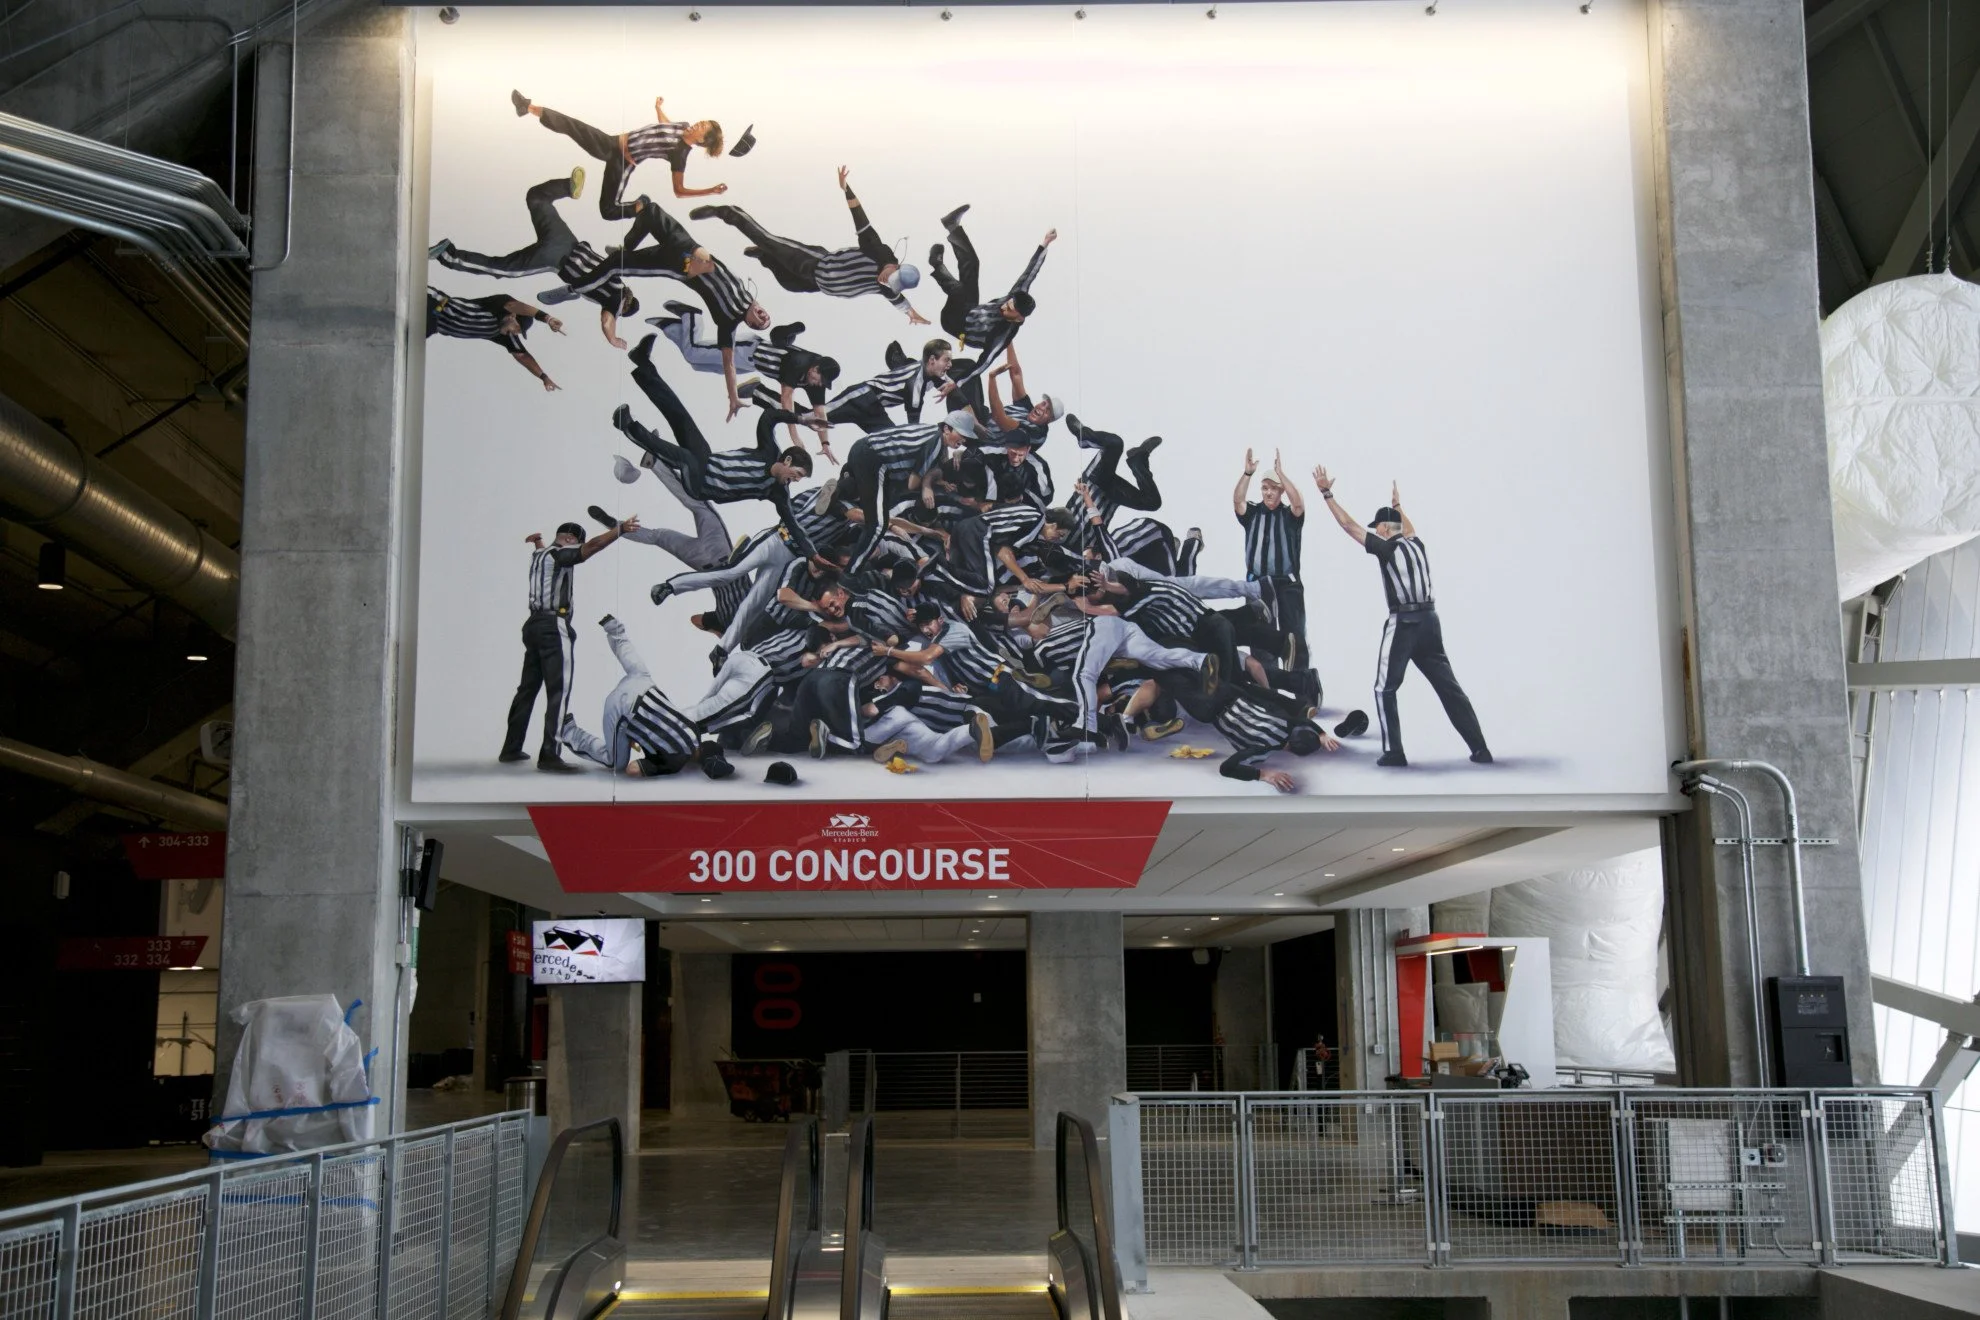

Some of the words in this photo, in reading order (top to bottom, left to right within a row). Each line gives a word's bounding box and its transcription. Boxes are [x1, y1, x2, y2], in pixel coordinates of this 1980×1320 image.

[821, 829, 879, 837] Mercedes-Benz
[158, 835, 209, 847] 304-333
[689, 850, 756, 882] 300
[769, 848, 1010, 882] CONCOURSE
[147, 939, 172, 951] 333
[113, 953, 139, 966] 332
[146, 953, 171, 966] 334
